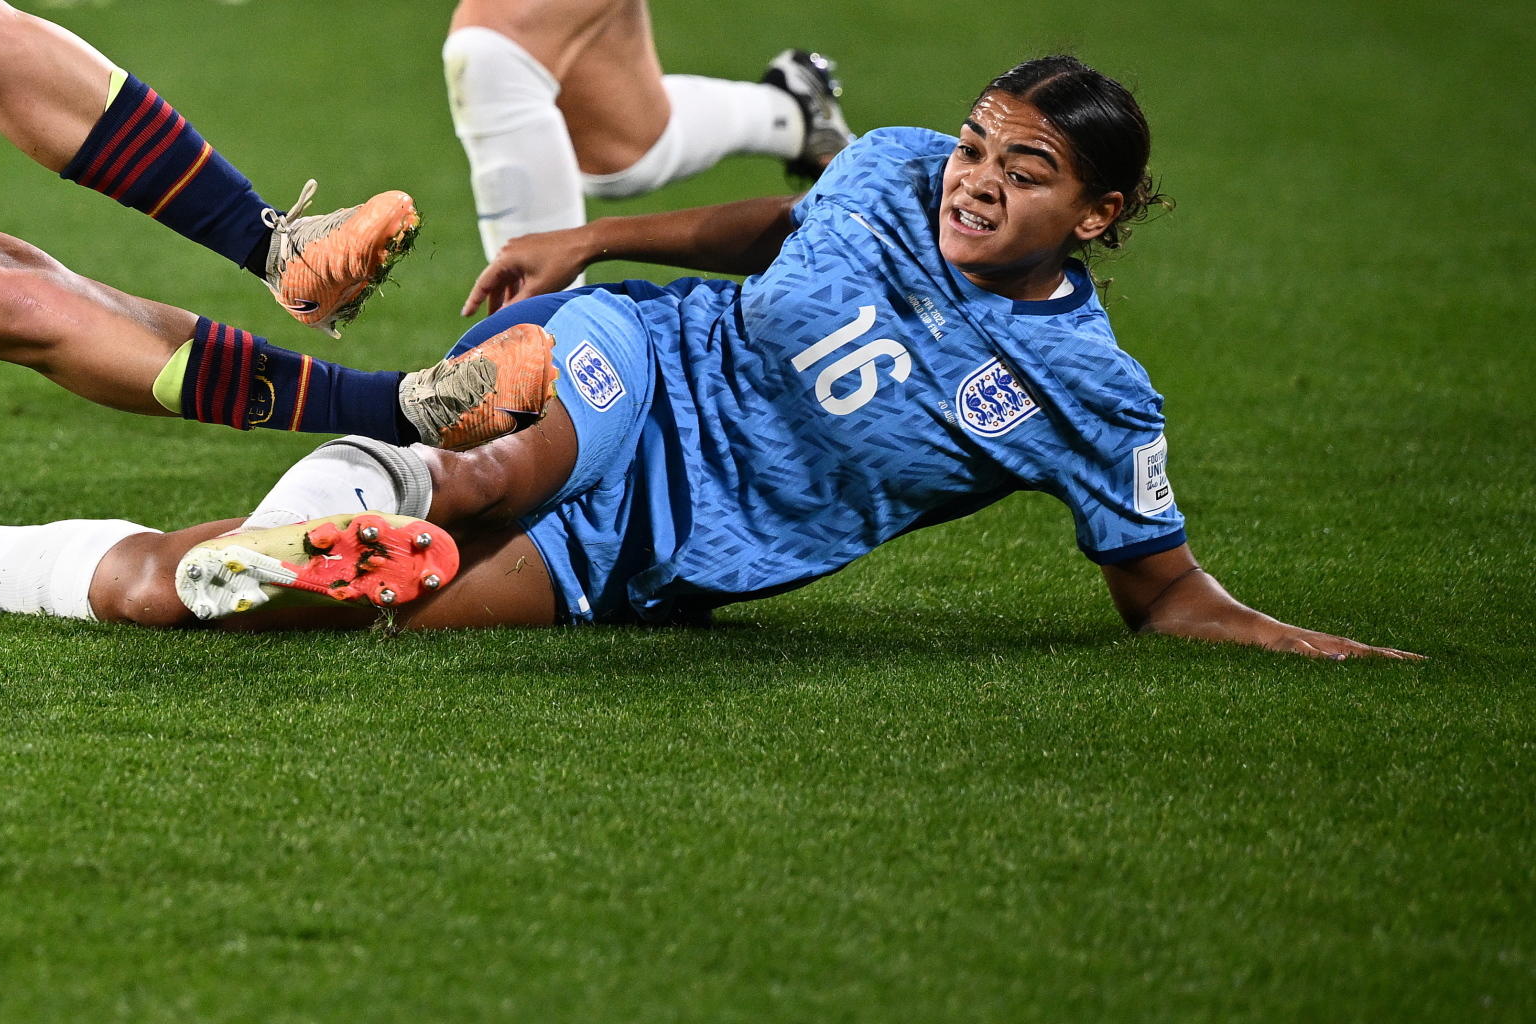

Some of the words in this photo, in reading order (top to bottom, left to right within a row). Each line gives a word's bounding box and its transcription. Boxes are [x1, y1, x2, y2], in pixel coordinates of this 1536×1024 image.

[921, 296, 935, 312] FIFA
[930, 308, 946, 326] 2023
[919, 312, 932, 324] CUP
[927, 323, 944, 342] FINAL
[791, 305, 912, 416] 16
[937, 399, 949, 410] 20
